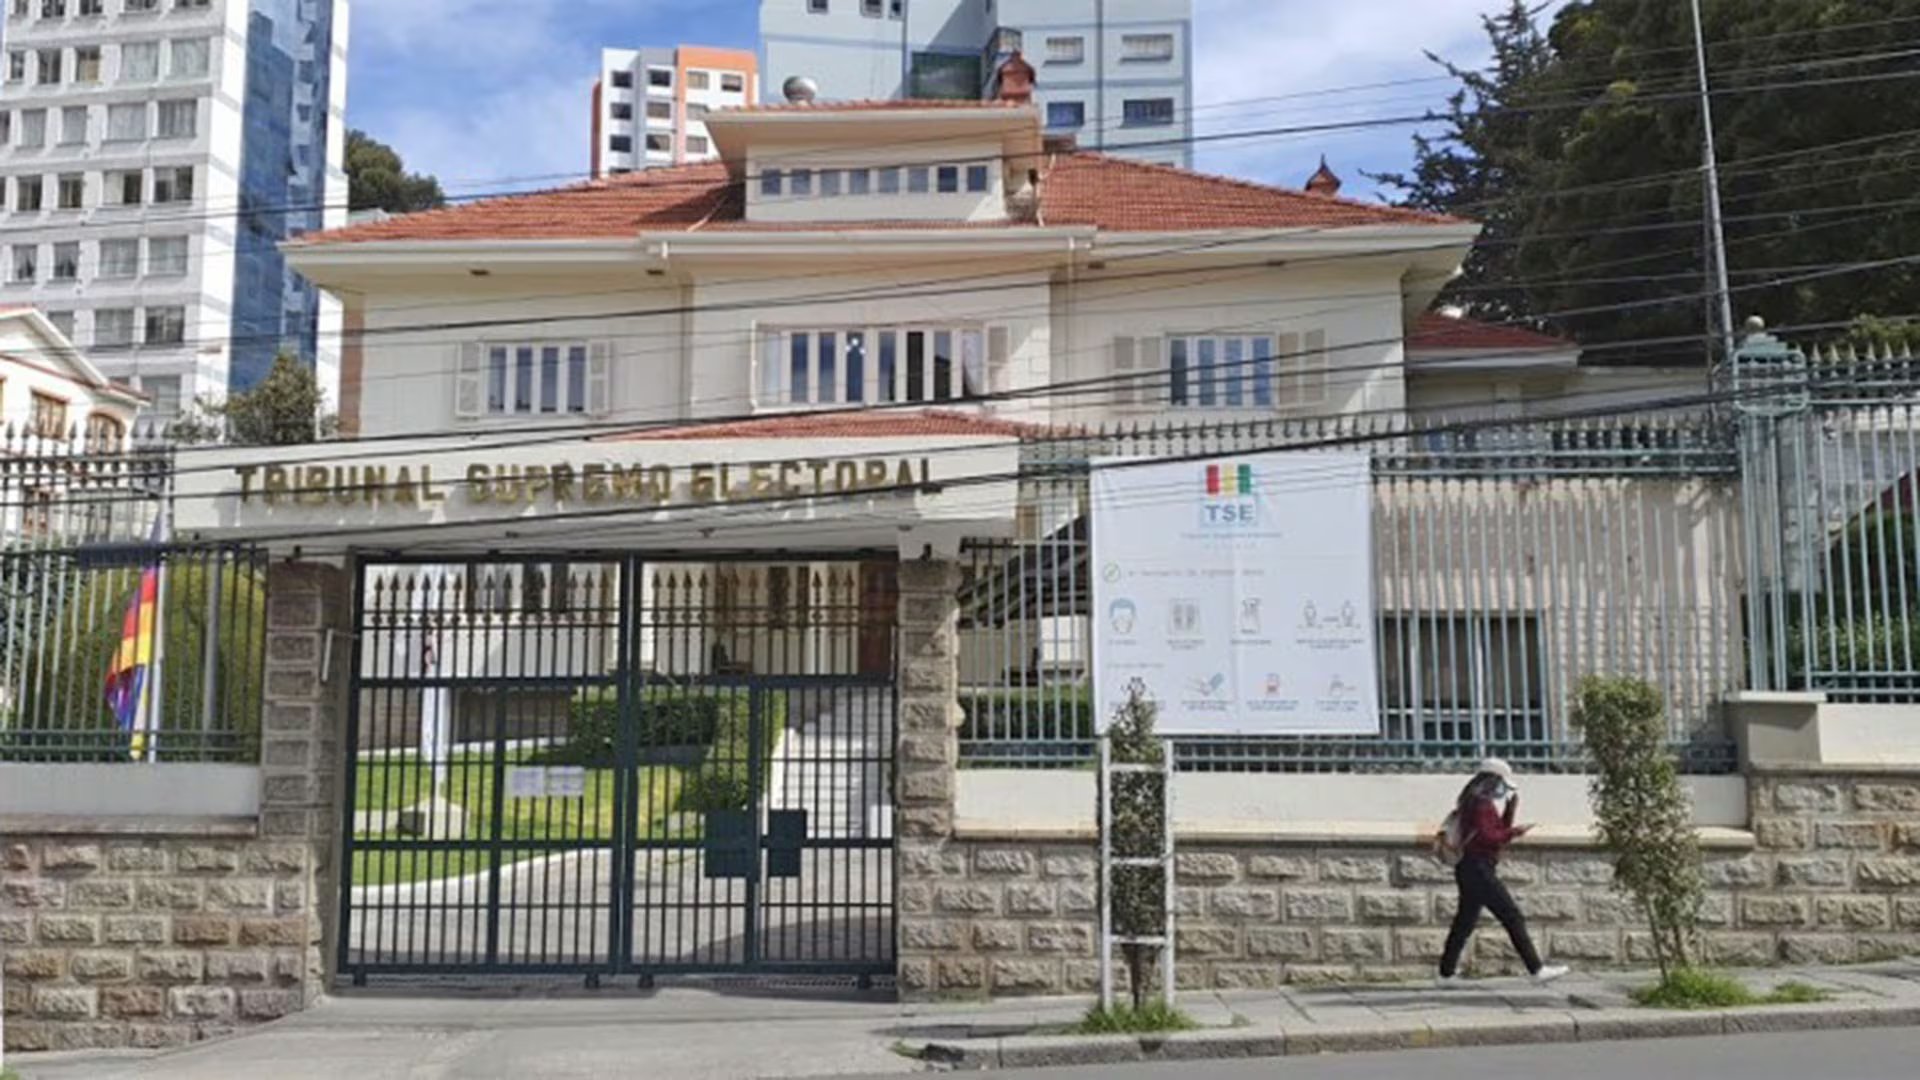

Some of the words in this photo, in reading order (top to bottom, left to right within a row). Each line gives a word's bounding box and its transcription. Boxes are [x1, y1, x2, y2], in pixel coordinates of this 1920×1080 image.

[234, 463, 446, 503] TRIBUNAL
[467, 462, 672, 503] SUPREMO
[690, 457, 943, 499] ELECTORAL
[1204, 504, 1254, 521] TSE
